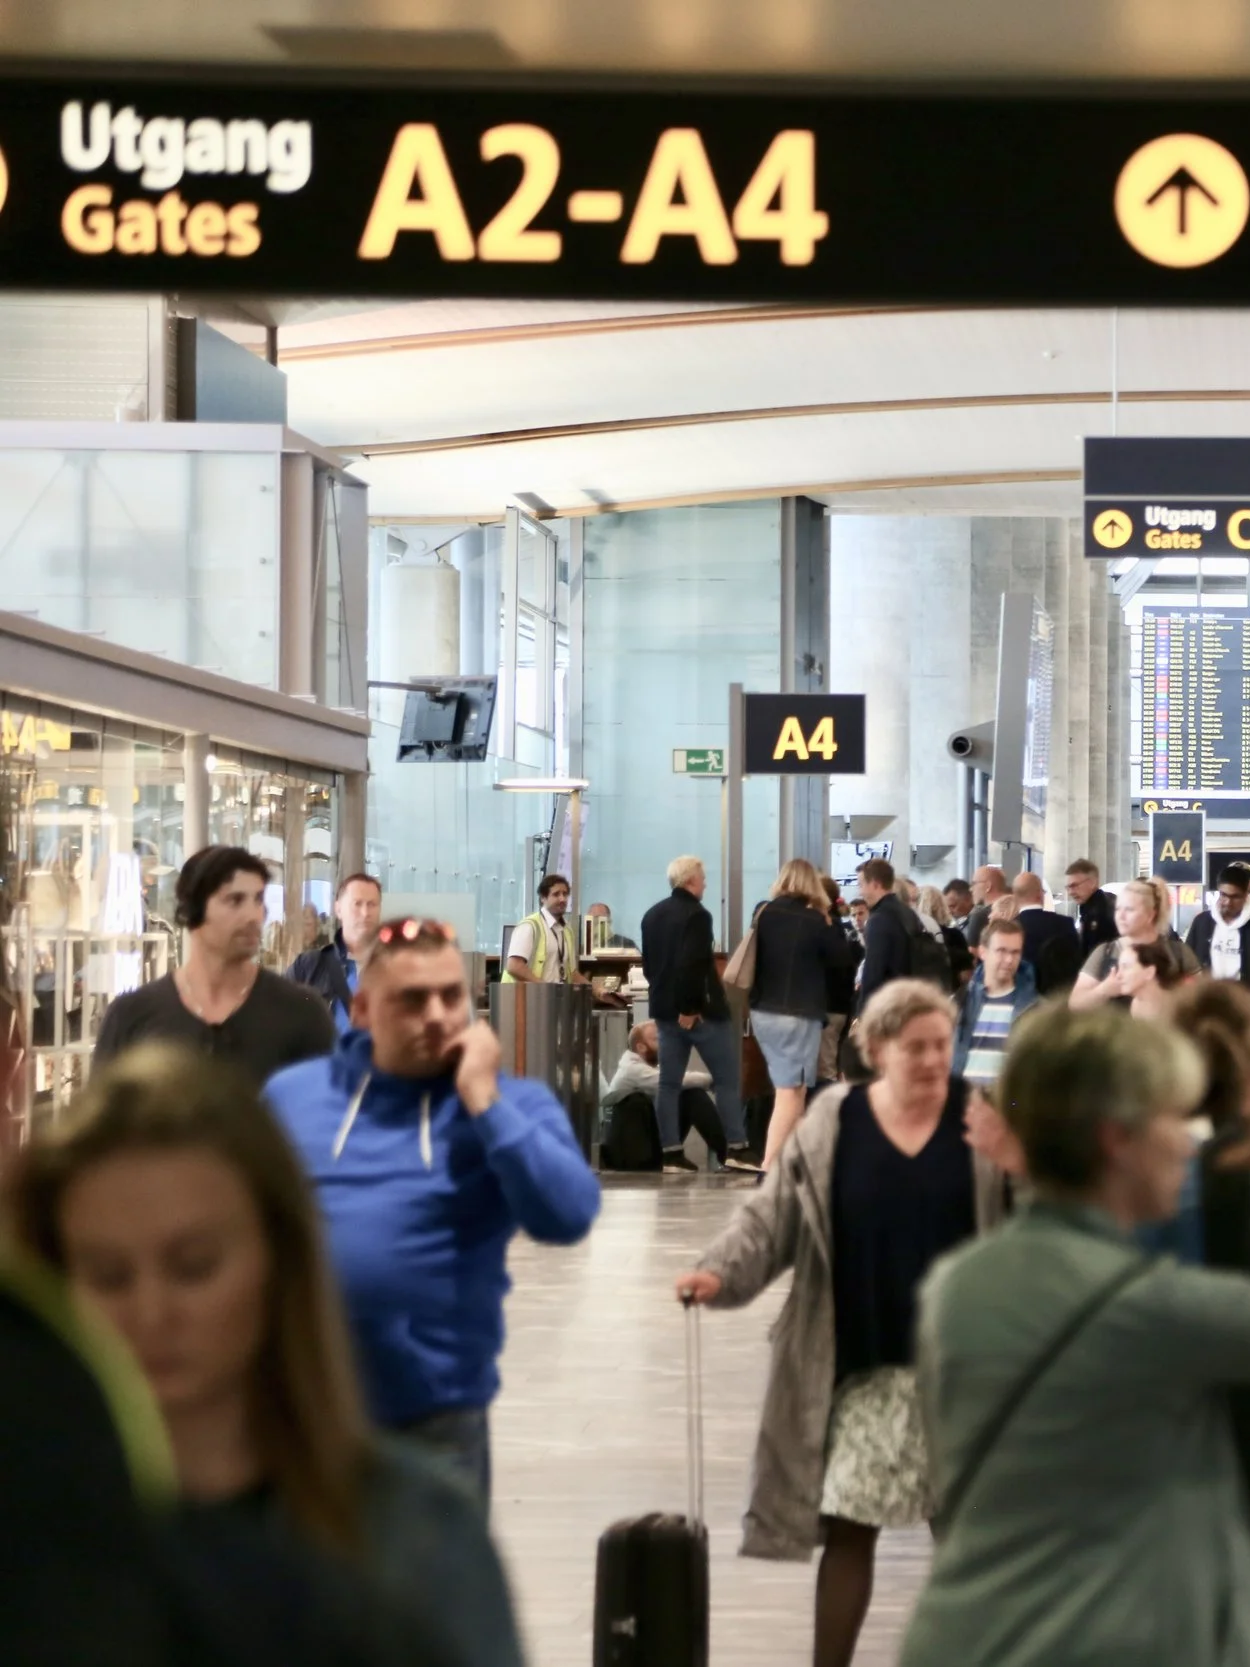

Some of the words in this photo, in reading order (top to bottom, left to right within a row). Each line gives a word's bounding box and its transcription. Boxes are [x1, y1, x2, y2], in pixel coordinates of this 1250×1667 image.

[60, 101, 312, 193] Utgang
[357, 123, 829, 266] A2-A4
[61, 184, 262, 257] Gates
[1145, 505, 1216, 530] Utgang
[1145, 529, 1201, 549] Gates
[772, 716, 838, 760] A4
[1159, 839, 1192, 862] A4
